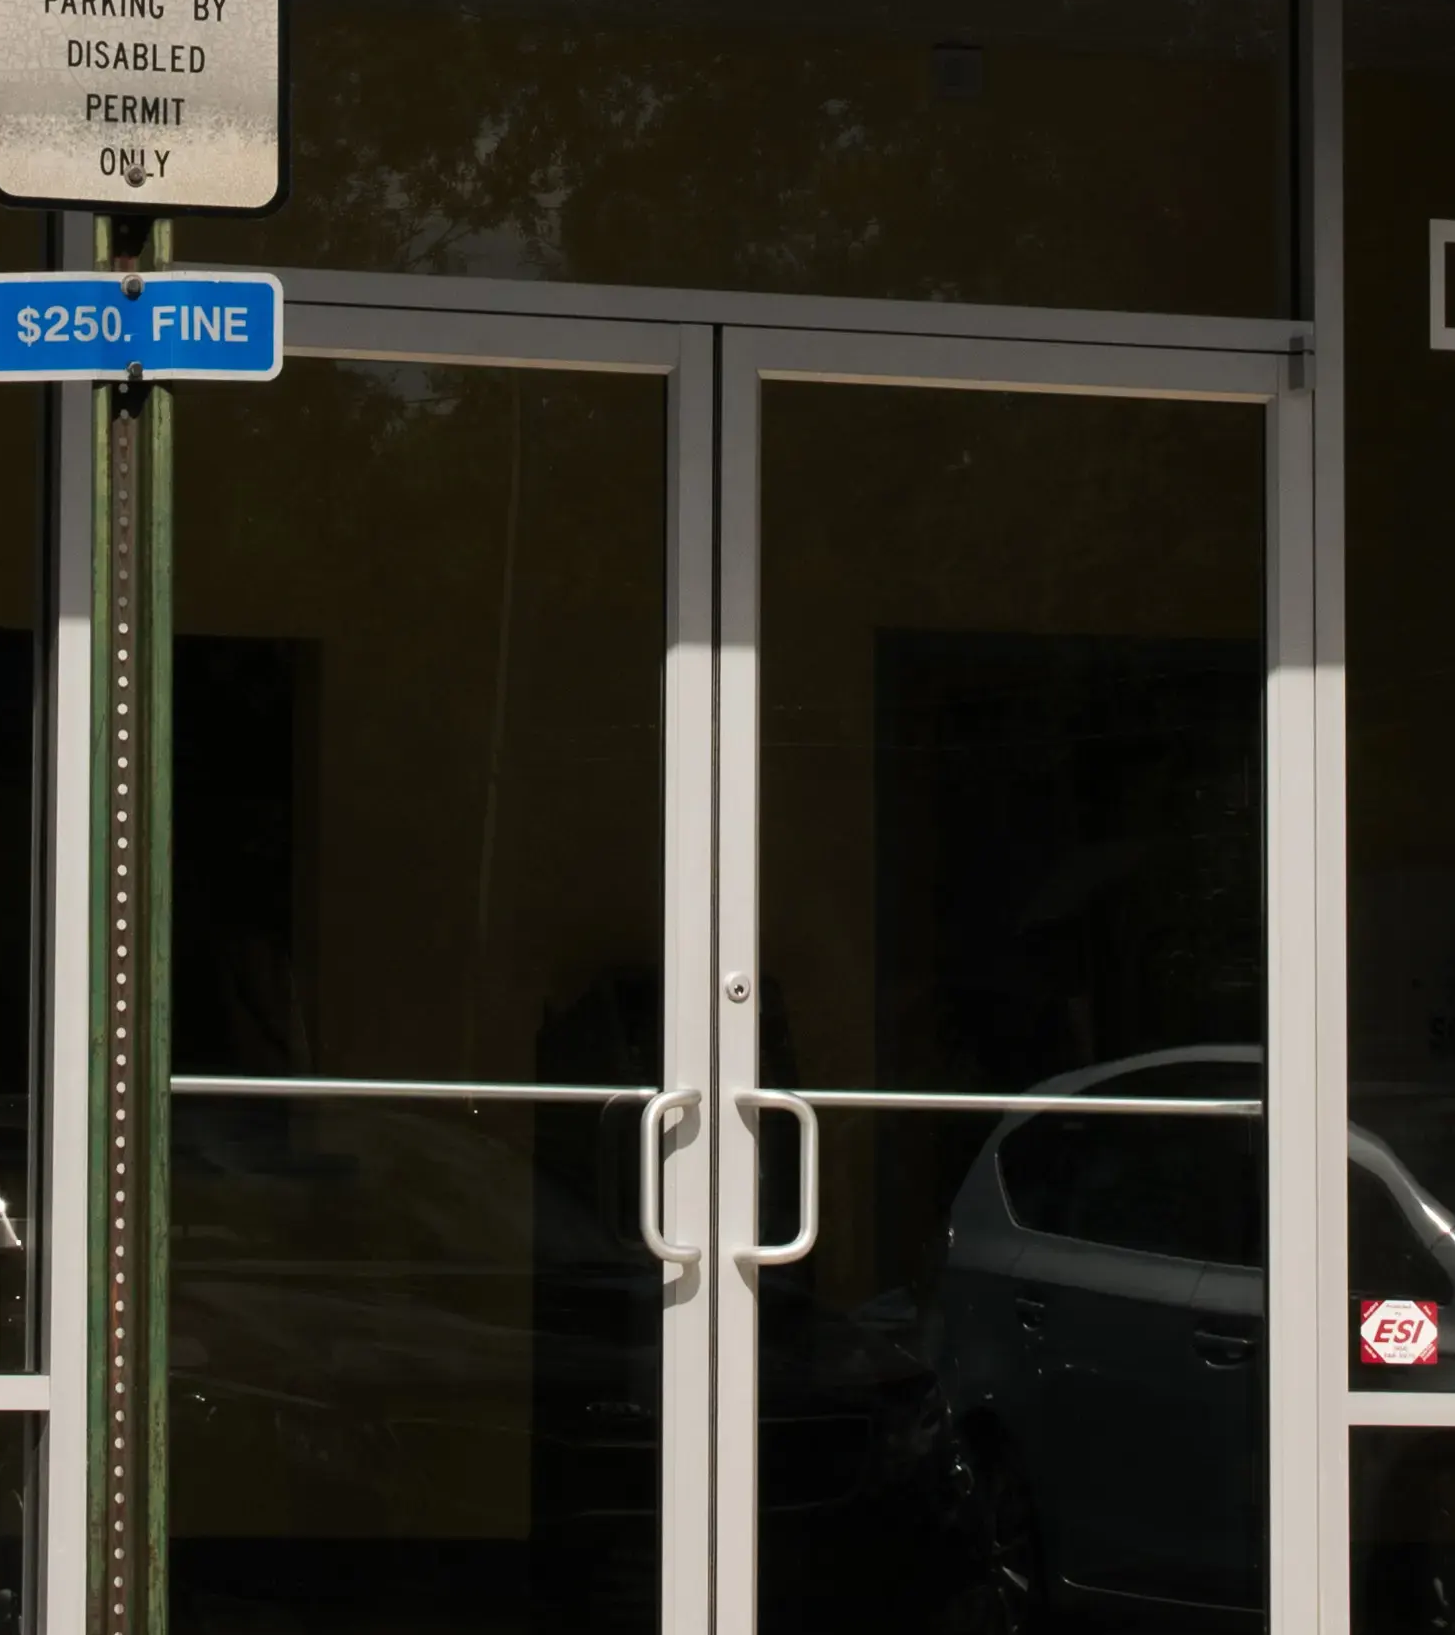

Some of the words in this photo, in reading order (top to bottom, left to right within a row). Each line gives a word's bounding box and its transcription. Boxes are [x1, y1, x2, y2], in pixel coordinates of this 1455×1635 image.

[67, 39, 205, 74] DISABLED
[86, 93, 185, 126] PERMIT
[100, 147, 170, 178] ONLY
[17, 305, 131, 347] $250.
[152, 305, 249, 342] FINE
[1373, 1319, 1425, 1344] ESI
